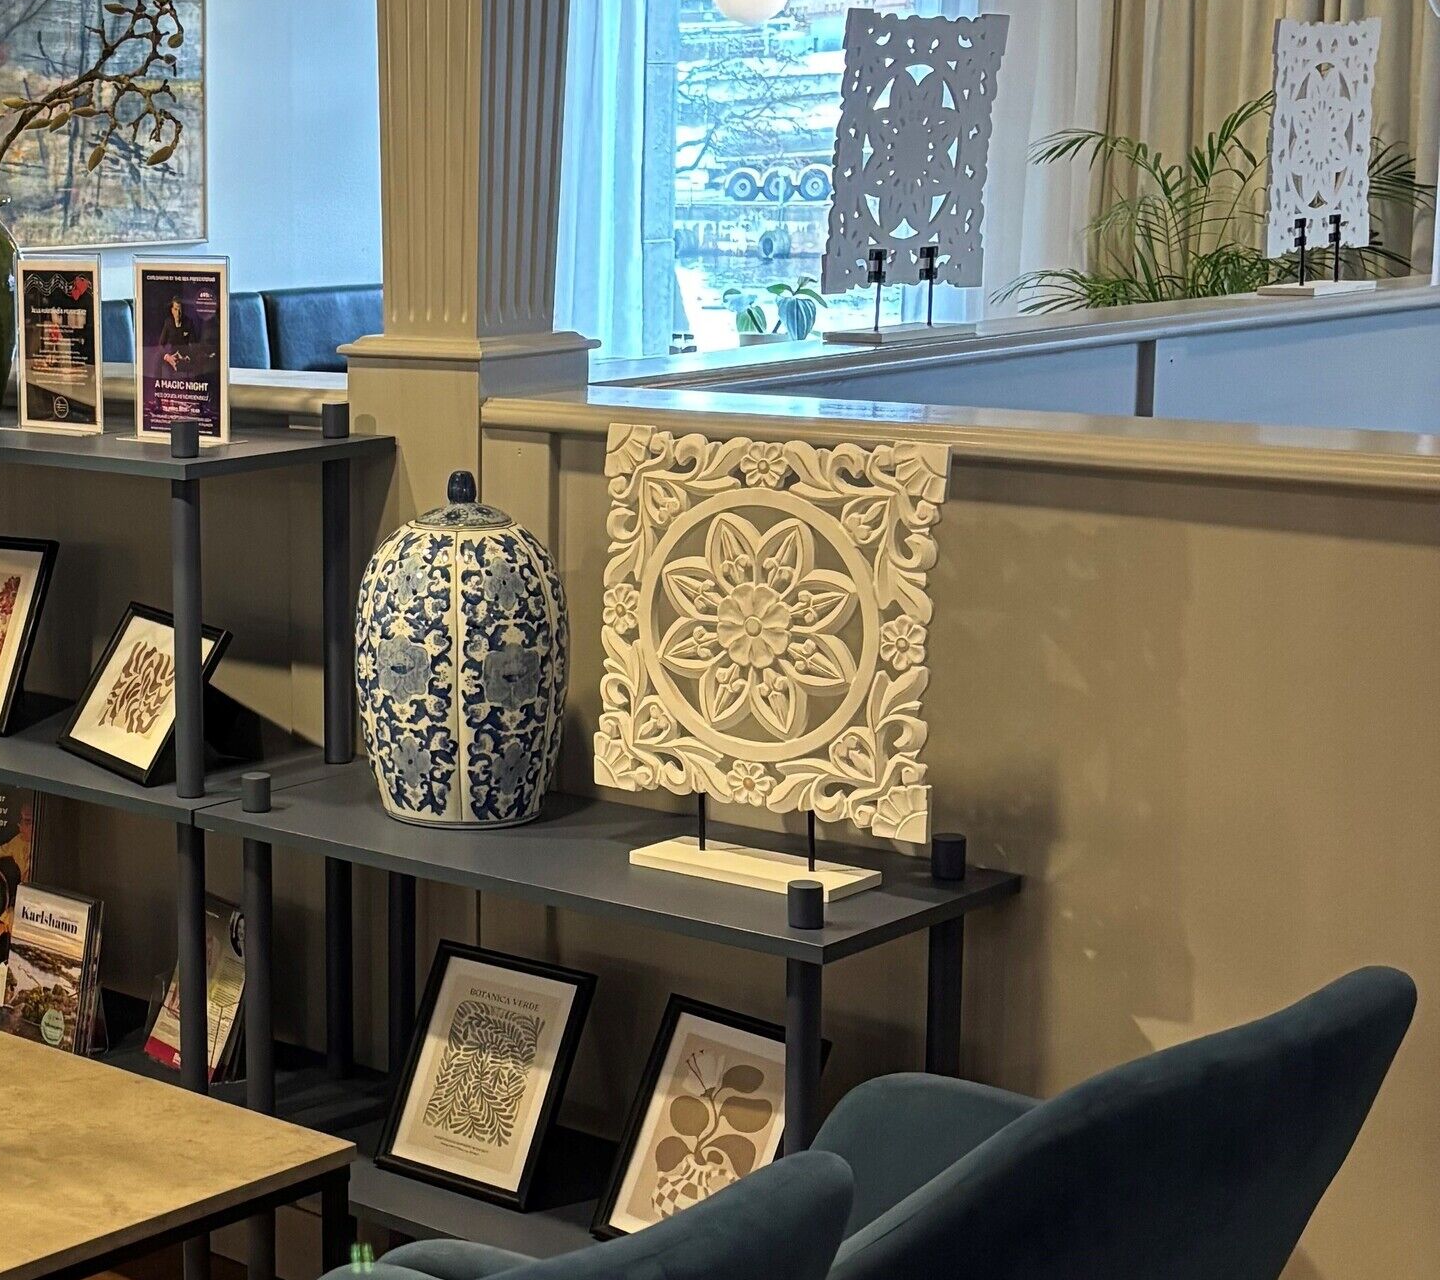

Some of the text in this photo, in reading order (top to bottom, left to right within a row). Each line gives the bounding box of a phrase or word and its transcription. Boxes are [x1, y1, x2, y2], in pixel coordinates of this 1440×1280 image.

[155, 380, 209, 391] A MAGIC NIGHT
[21, 906, 78, 935] Karlshamn
[470, 988, 539, 1011] BOTANICA VERDE
